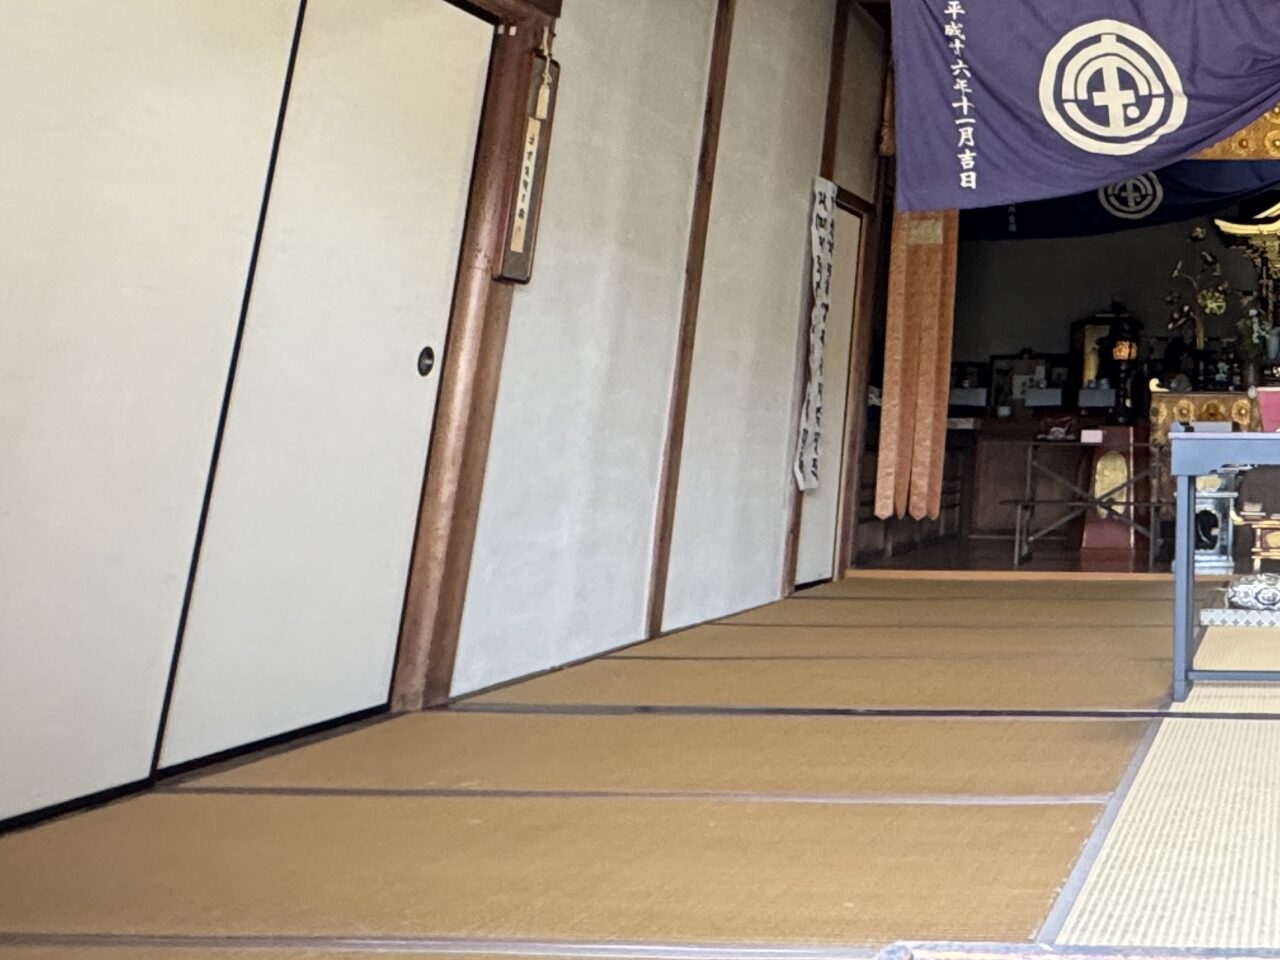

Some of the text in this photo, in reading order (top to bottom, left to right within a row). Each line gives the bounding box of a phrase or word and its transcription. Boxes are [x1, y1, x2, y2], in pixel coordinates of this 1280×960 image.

[944, 0, 977, 189] 平成十六年十一月吉日
